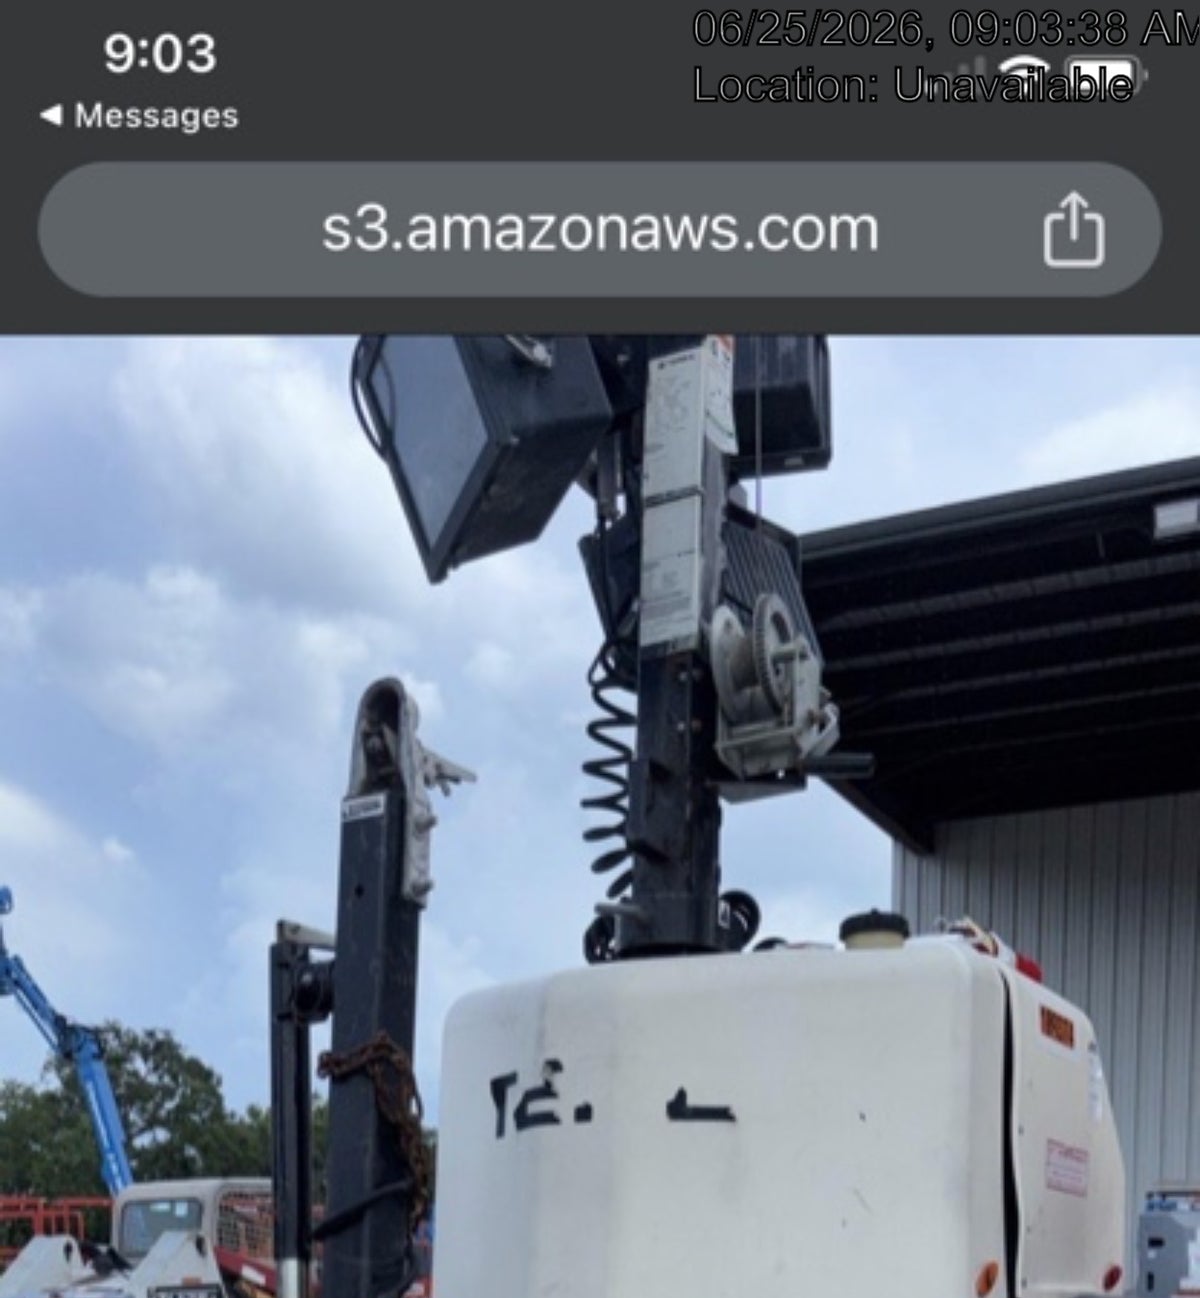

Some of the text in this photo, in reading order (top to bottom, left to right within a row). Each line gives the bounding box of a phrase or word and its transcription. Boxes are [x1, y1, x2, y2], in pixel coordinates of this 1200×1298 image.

[105, 33, 216, 74] 9:03
[75, 101, 239, 135] Messages
[324, 203, 879, 251] s3.amazonaws.com
